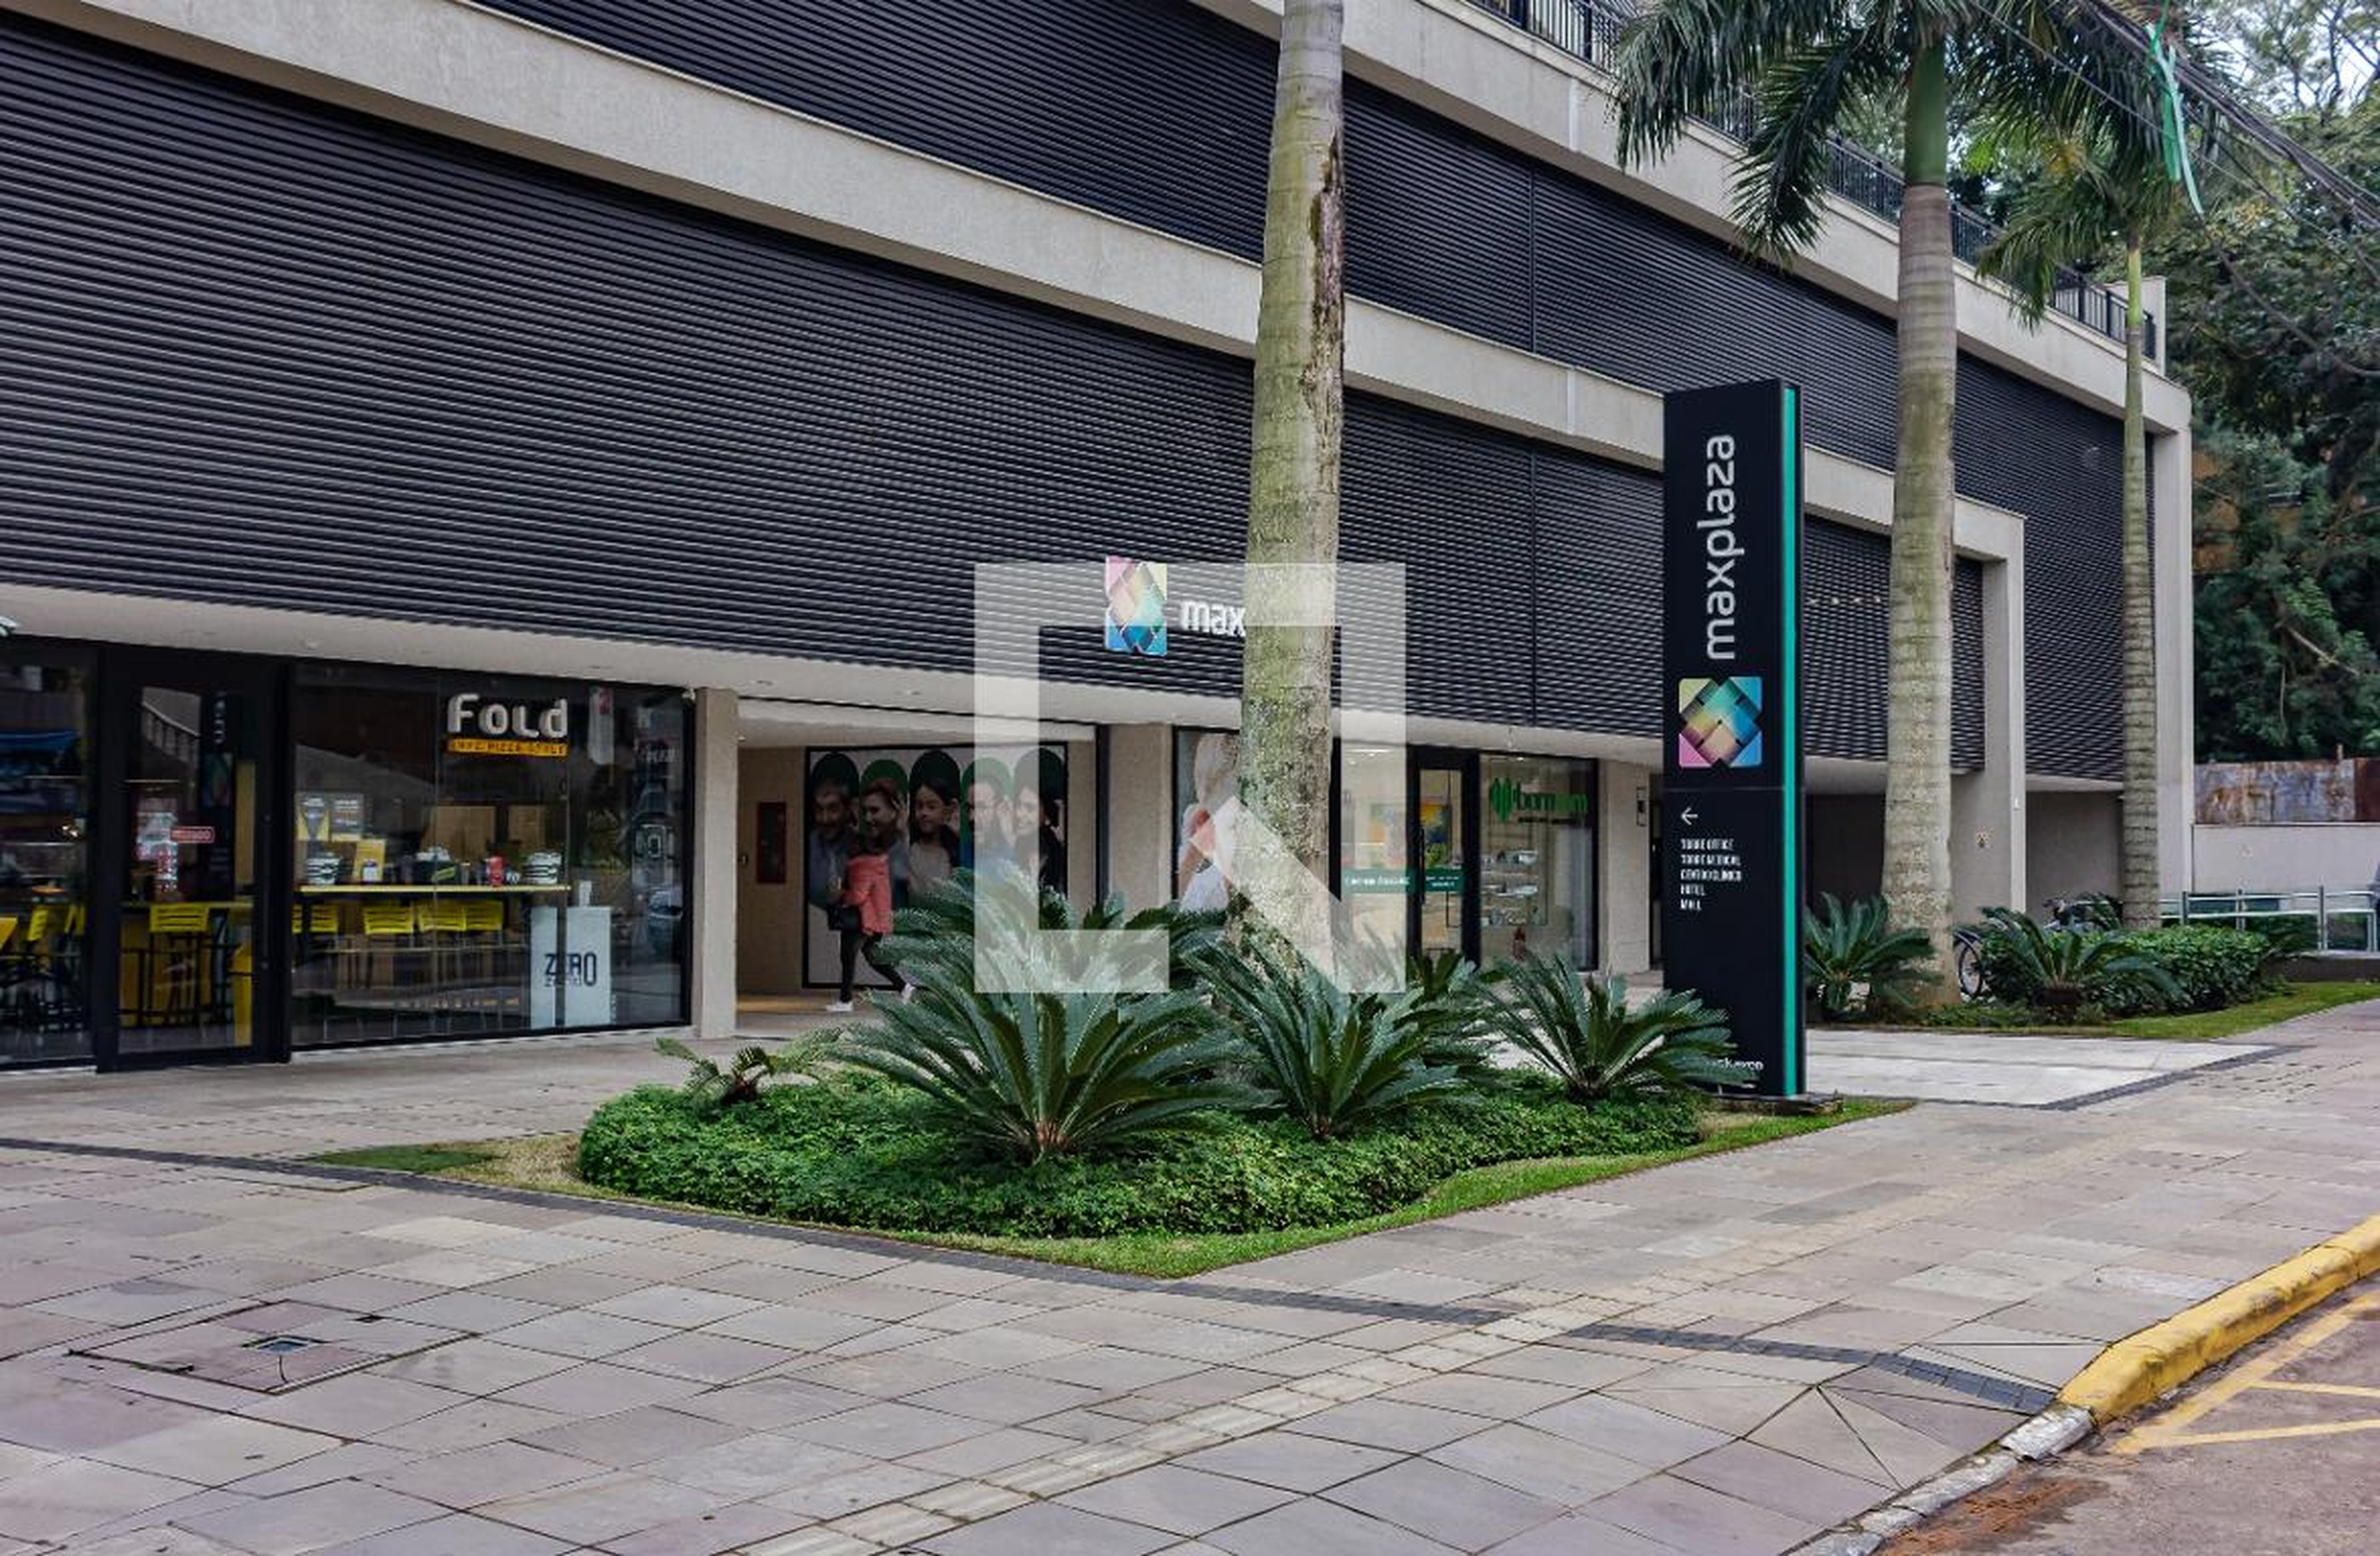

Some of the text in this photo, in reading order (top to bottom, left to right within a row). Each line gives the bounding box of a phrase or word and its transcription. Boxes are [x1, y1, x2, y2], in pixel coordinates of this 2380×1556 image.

[1697, 435, 1745, 659] maxplaza
[1181, 600, 1246, 637] max
[544, 952, 597, 988] ZRO
